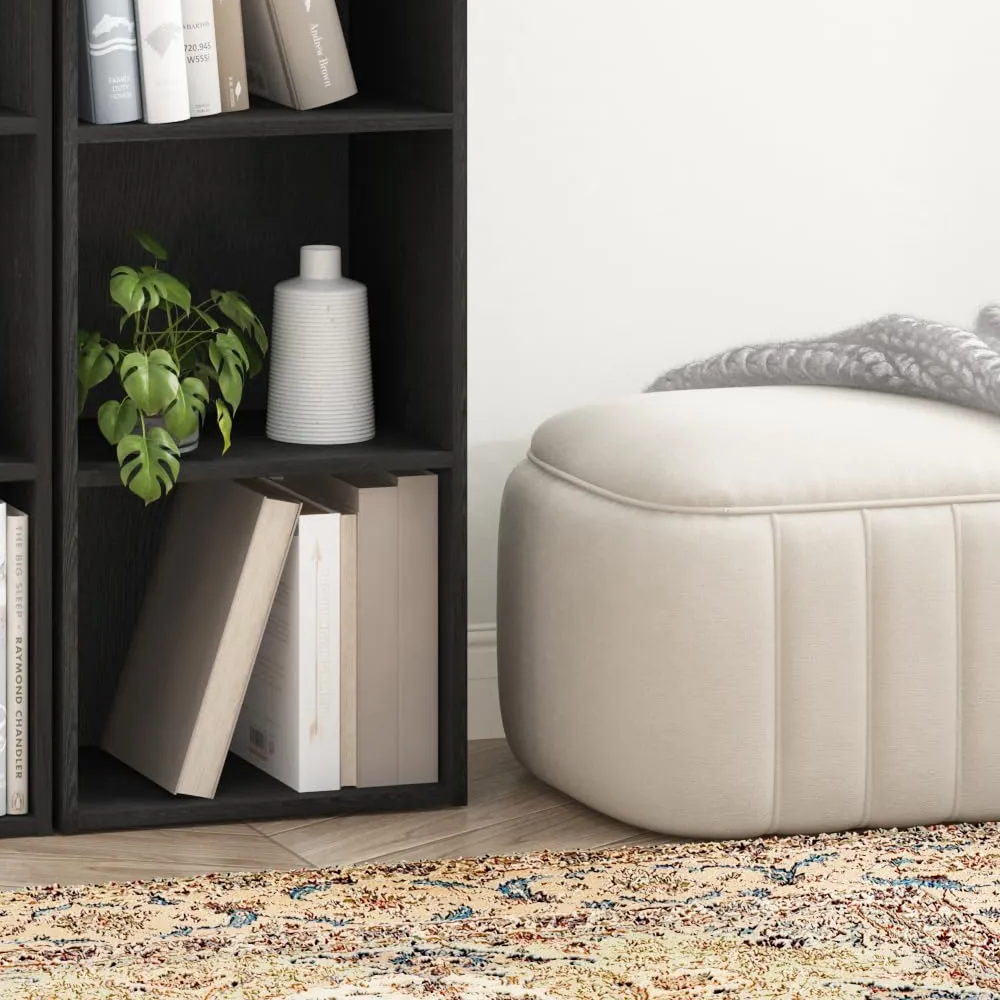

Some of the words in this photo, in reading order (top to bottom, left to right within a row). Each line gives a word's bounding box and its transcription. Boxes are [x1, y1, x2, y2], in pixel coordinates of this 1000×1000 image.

[183, 41, 212, 52] 720.945
[309, 22, 323, 56] Andrew
[318, 57, 333, 88] Brown
[15, 526, 23, 549] THE
[15, 555, 23, 577] BIG
[15, 582, 23, 618] SLEEP
[15, 636, 23, 705] RAYMOND
[15, 710, 23, 779] CHANDLER
